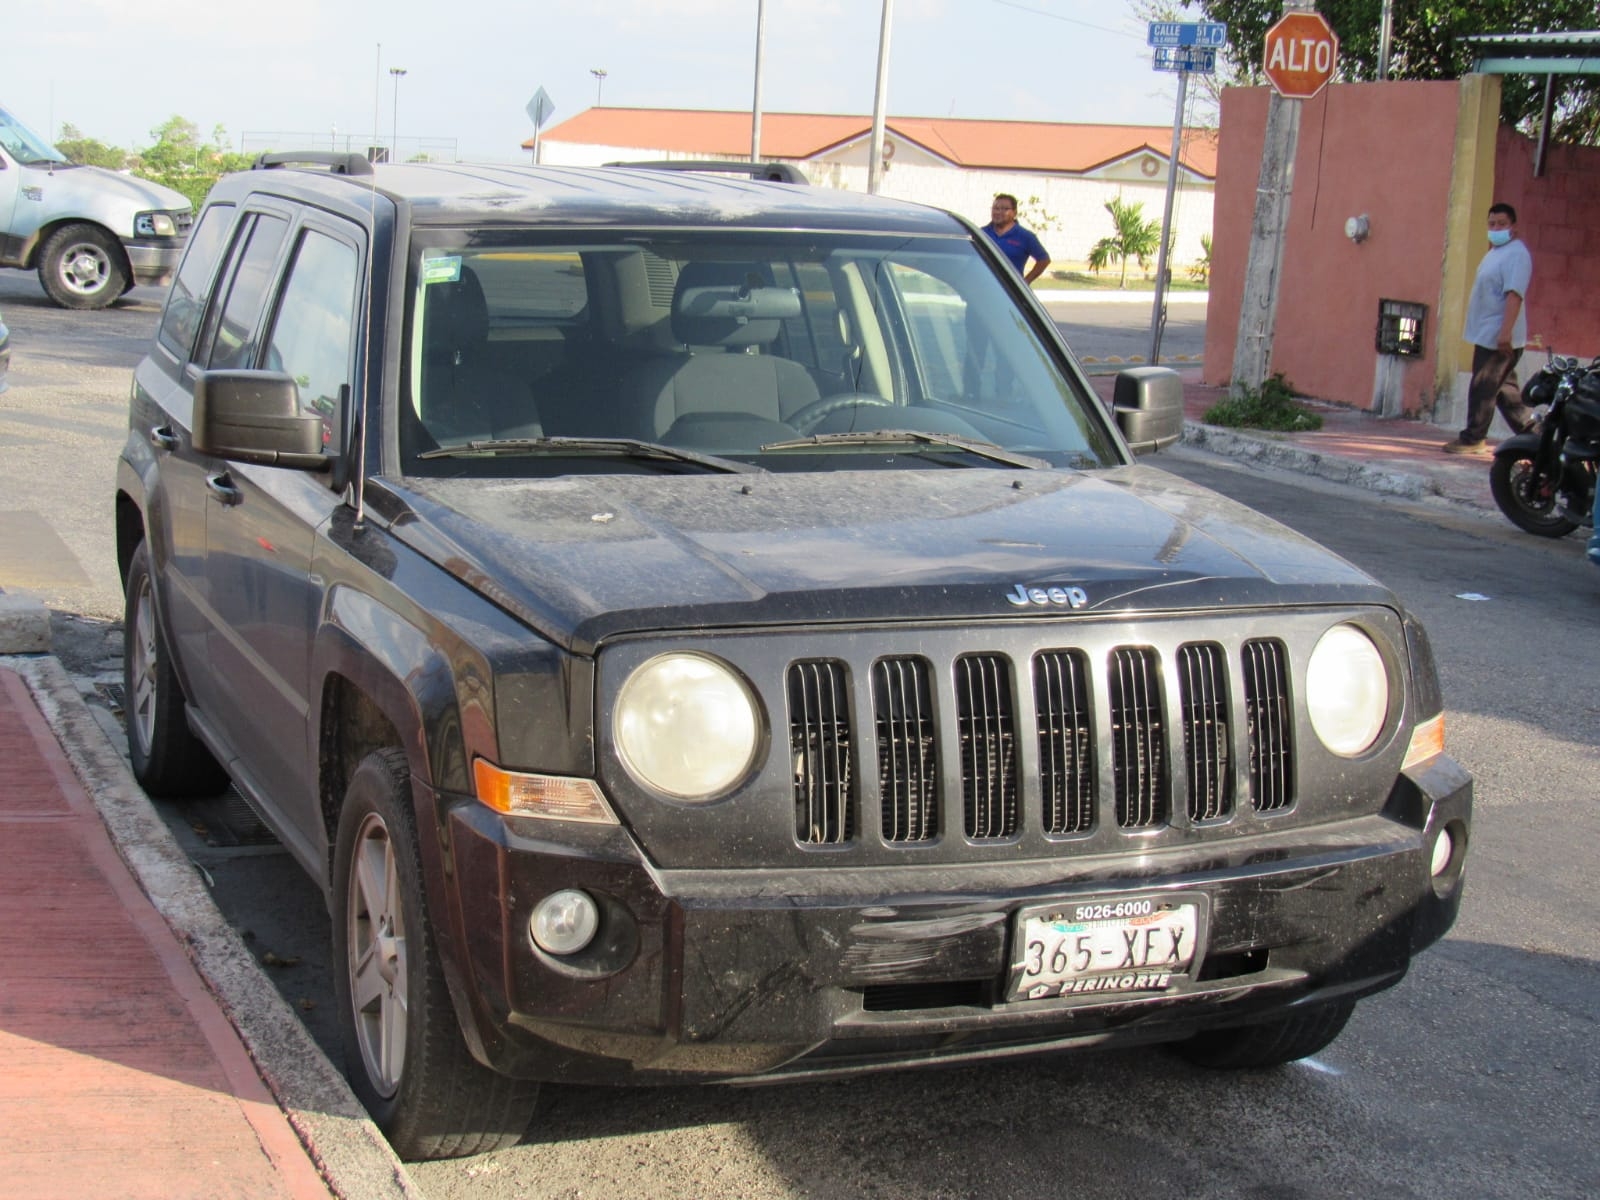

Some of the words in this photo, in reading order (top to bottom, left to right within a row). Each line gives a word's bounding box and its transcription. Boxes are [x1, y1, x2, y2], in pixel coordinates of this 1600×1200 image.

[1154, 24, 1180, 37] CALLE
[1269, 37, 1331, 74] ALTO
[1006, 583, 1088, 609] Jeep
[1075, 900, 1151, 920] 5026-6000
[1026, 926, 1185, 977] 365-XFX
[1060, 973, 1170, 994] PERINORTE
